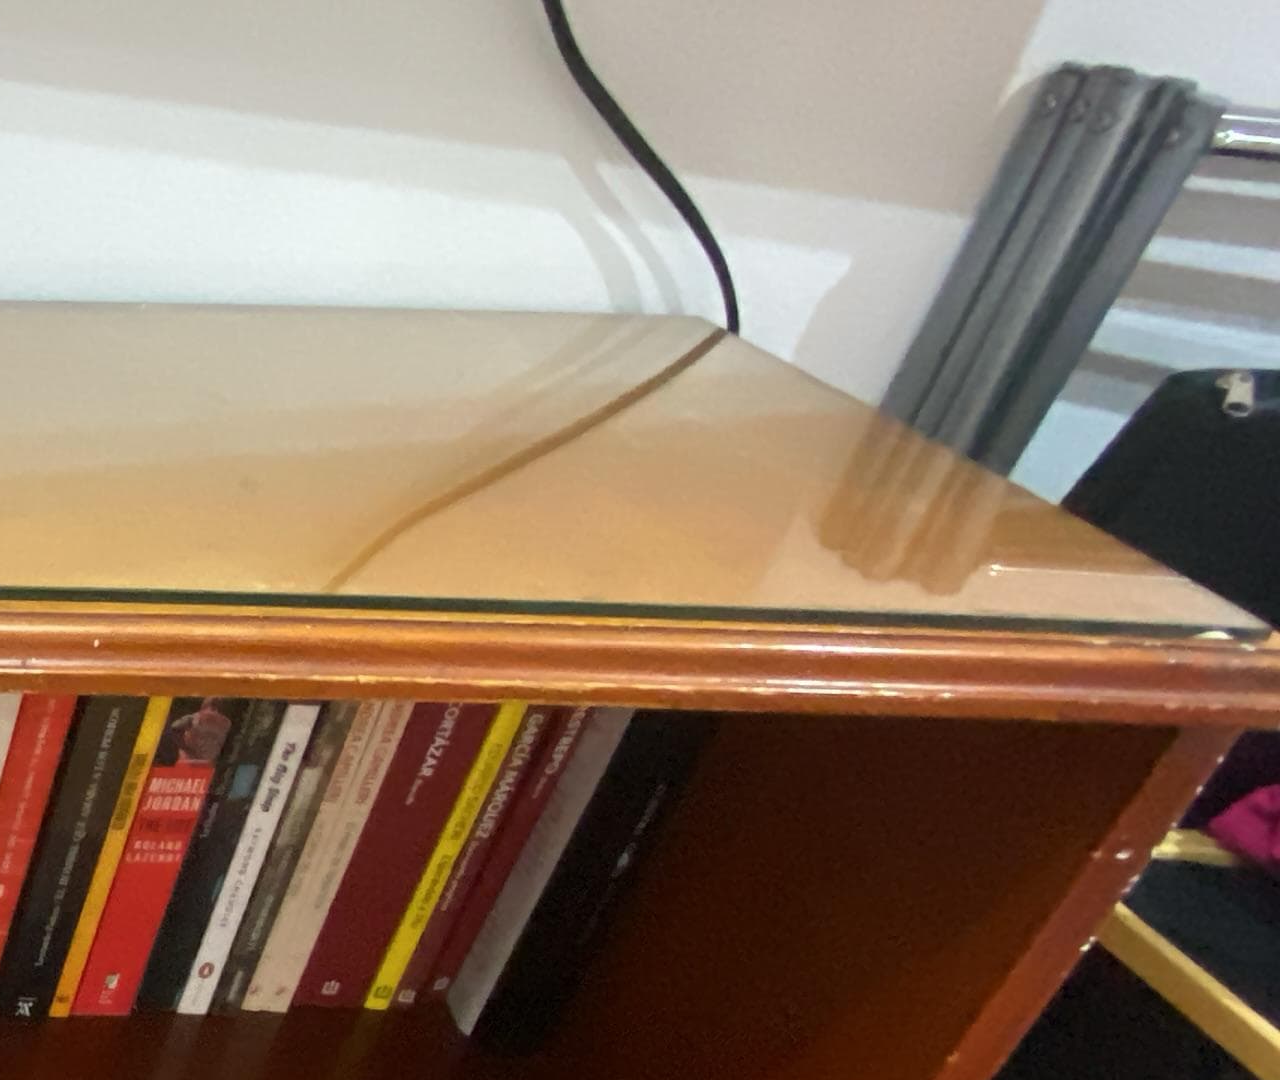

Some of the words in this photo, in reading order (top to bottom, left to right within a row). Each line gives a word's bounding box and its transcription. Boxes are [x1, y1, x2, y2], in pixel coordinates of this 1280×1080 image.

[268, 762, 288, 786] Big
[148, 777, 206, 794] MICHAEL
[142, 795, 201, 811] JORDAN
